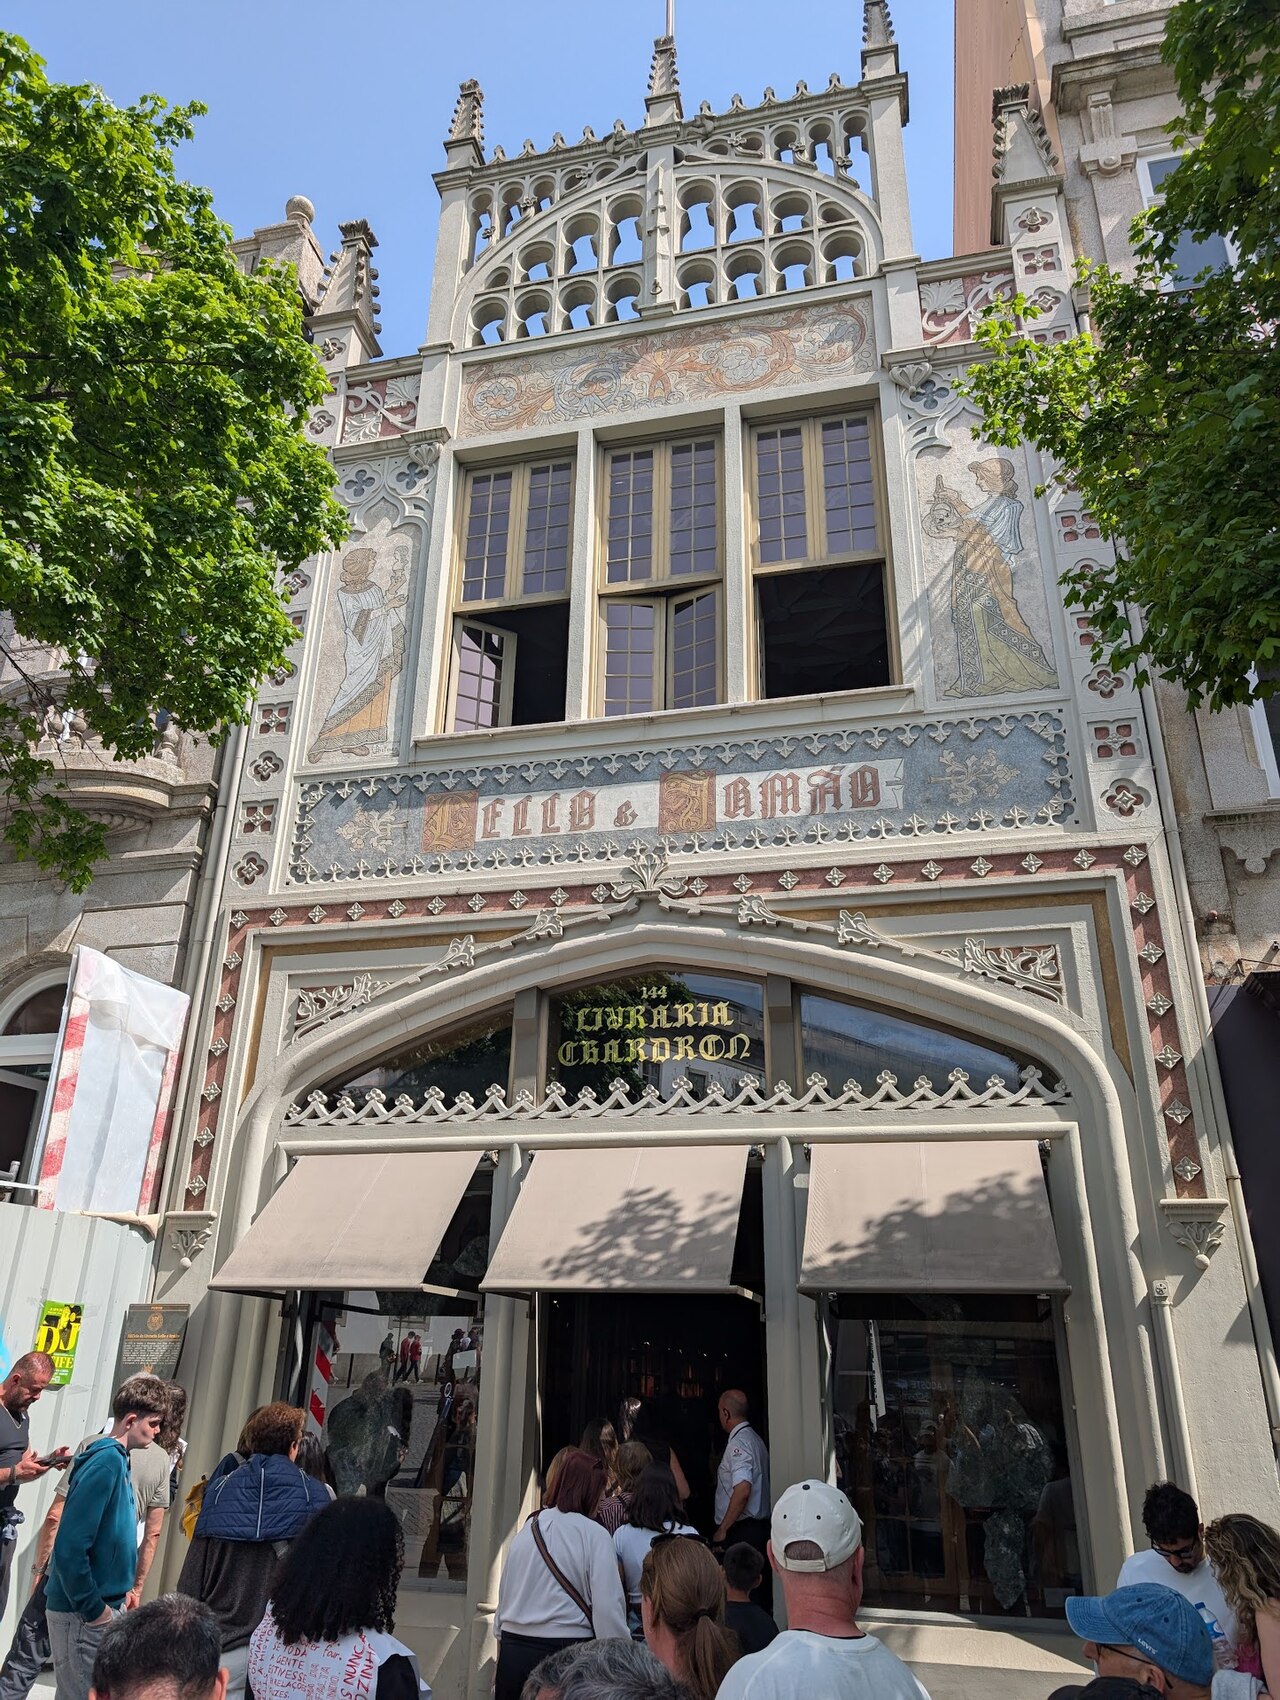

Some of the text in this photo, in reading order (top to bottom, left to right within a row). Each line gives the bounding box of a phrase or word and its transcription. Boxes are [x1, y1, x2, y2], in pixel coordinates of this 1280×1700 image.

[422, 789, 598, 853] LELLO
[640, 986, 669, 1000] 144
[575, 1001, 734, 1032] LIVRARIA
[558, 1033, 750, 1067] CHARDRON
